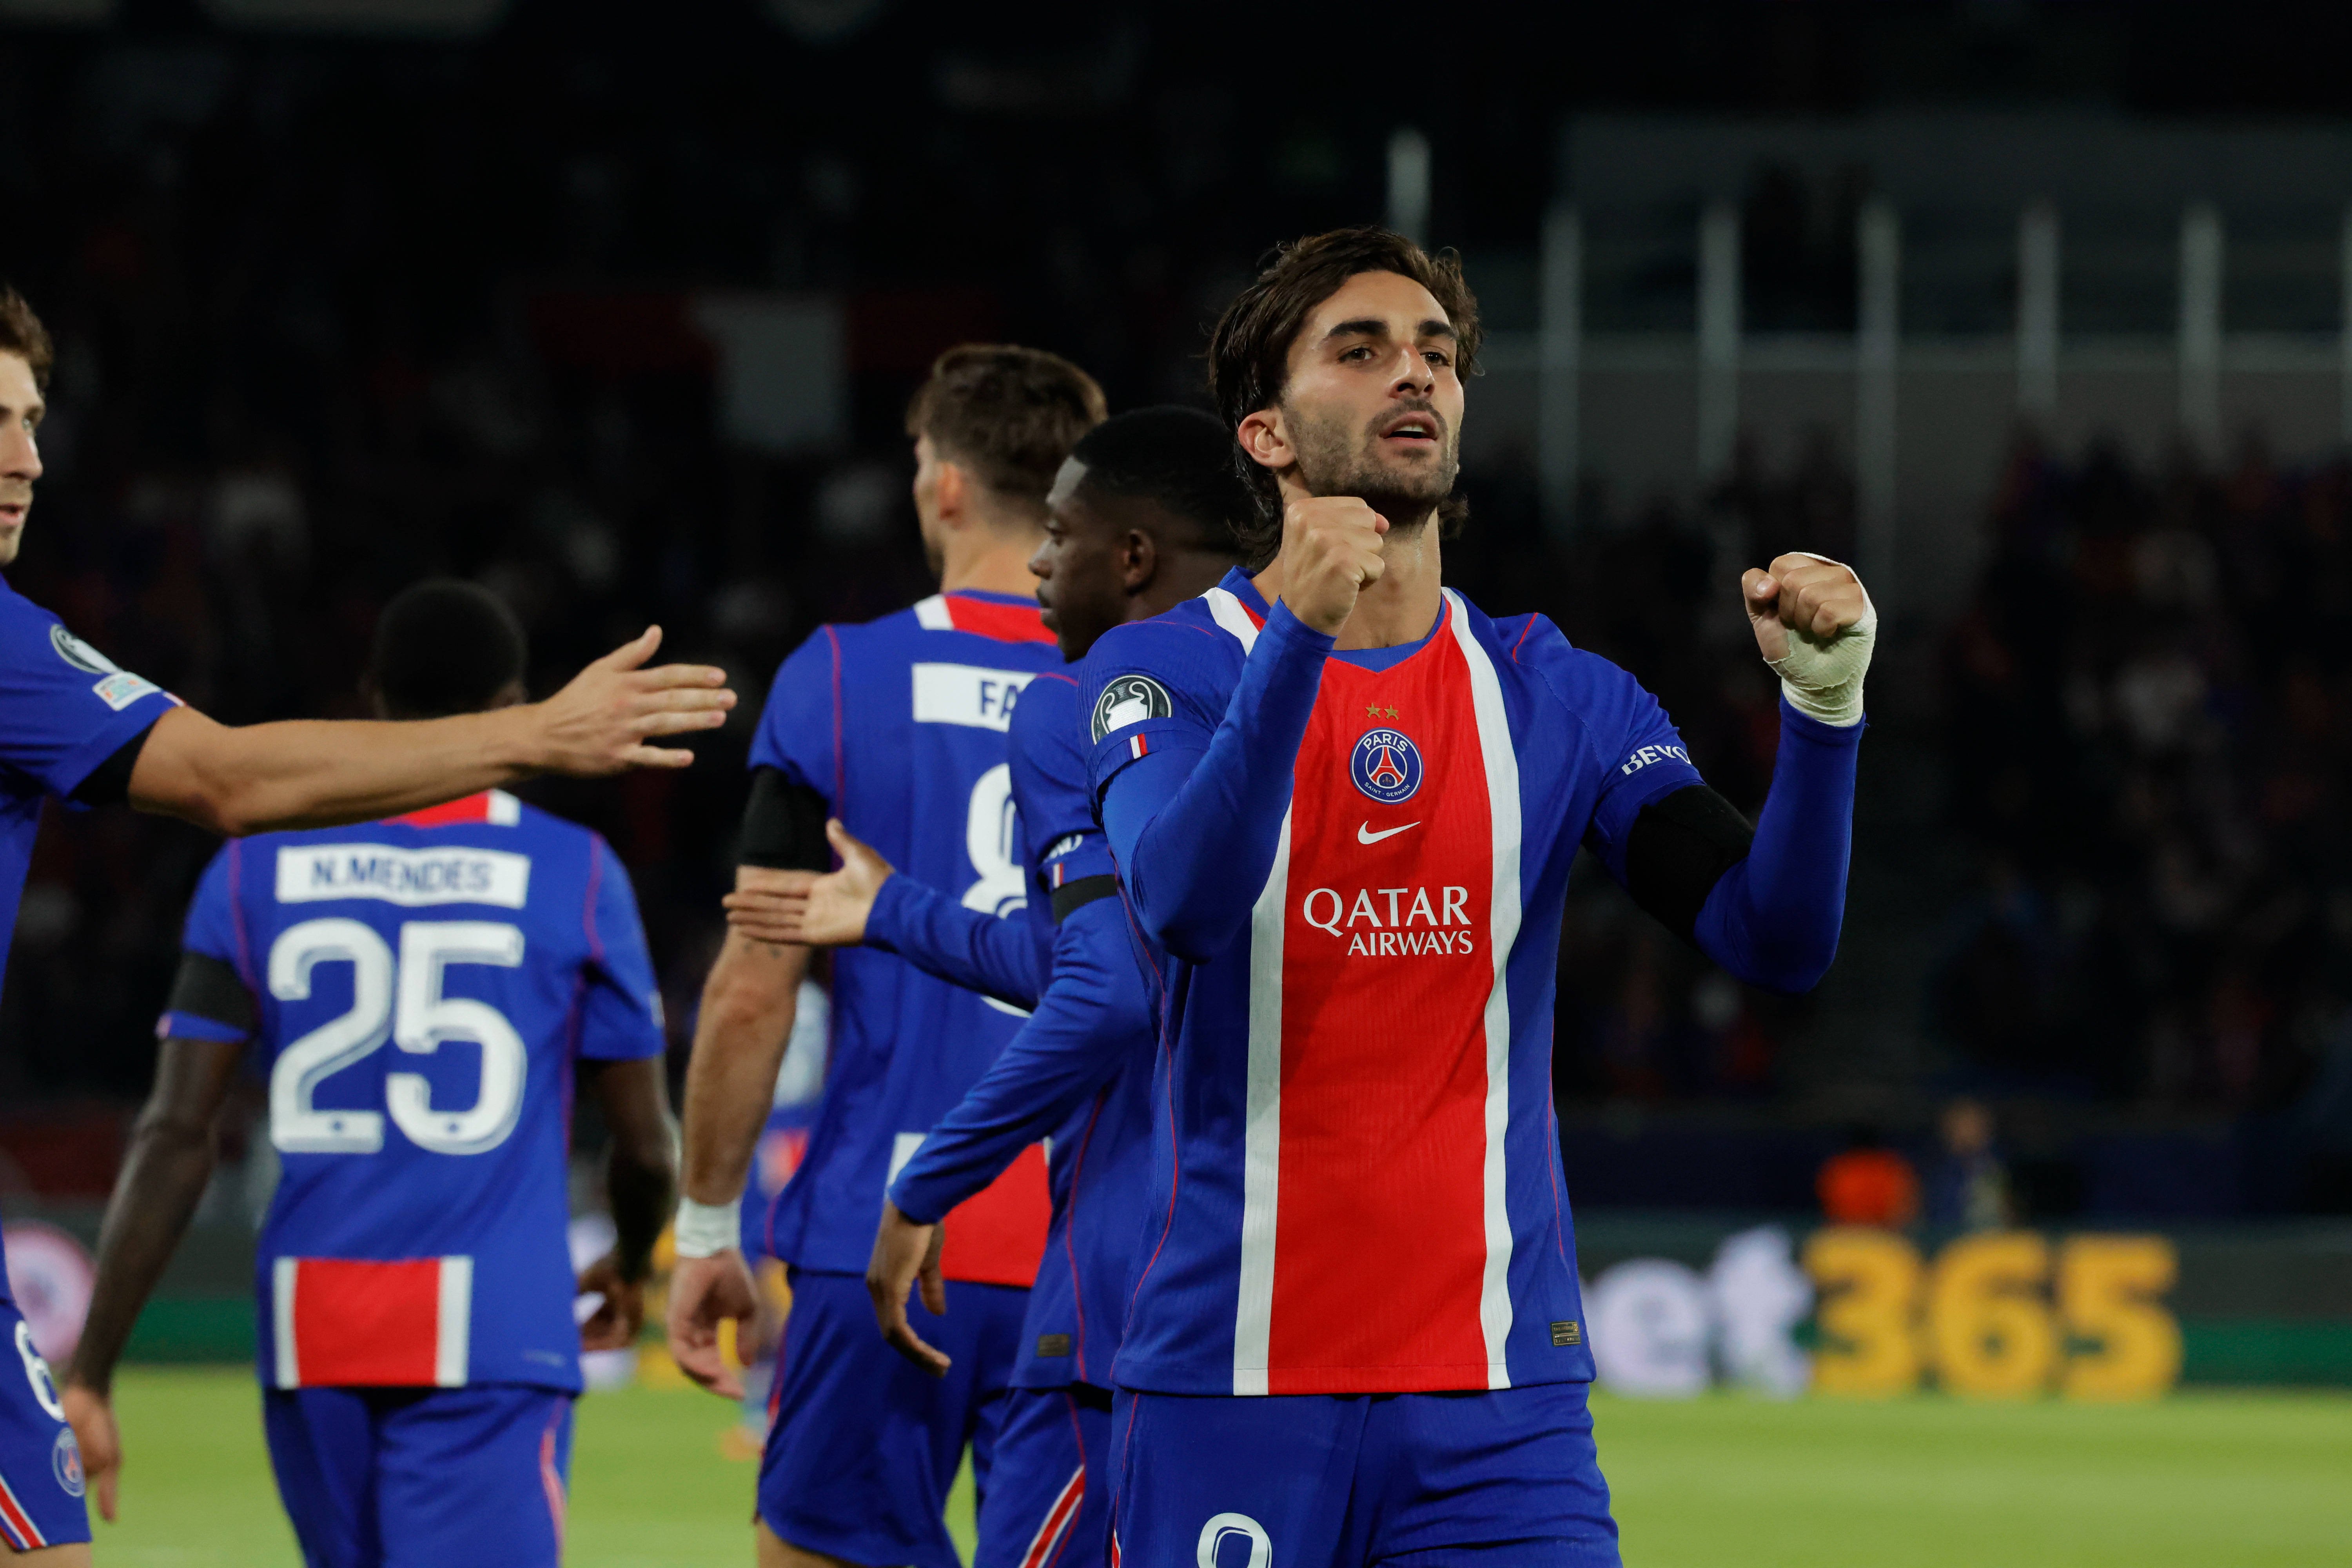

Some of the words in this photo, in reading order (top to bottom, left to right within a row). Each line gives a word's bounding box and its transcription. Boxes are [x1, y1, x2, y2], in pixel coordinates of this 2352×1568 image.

[1363, 733, 1408, 752] PARIS
[1364, 782, 1381, 795] SAINT
[1386, 784, 1410, 797] GERMAIN
[1303, 886, 1472, 938] QATAR
[1347, 930, 1473, 956] AIRWAYS
[267, 917, 528, 1156] 25
[1581, 1226, 2183, 1401] et365
